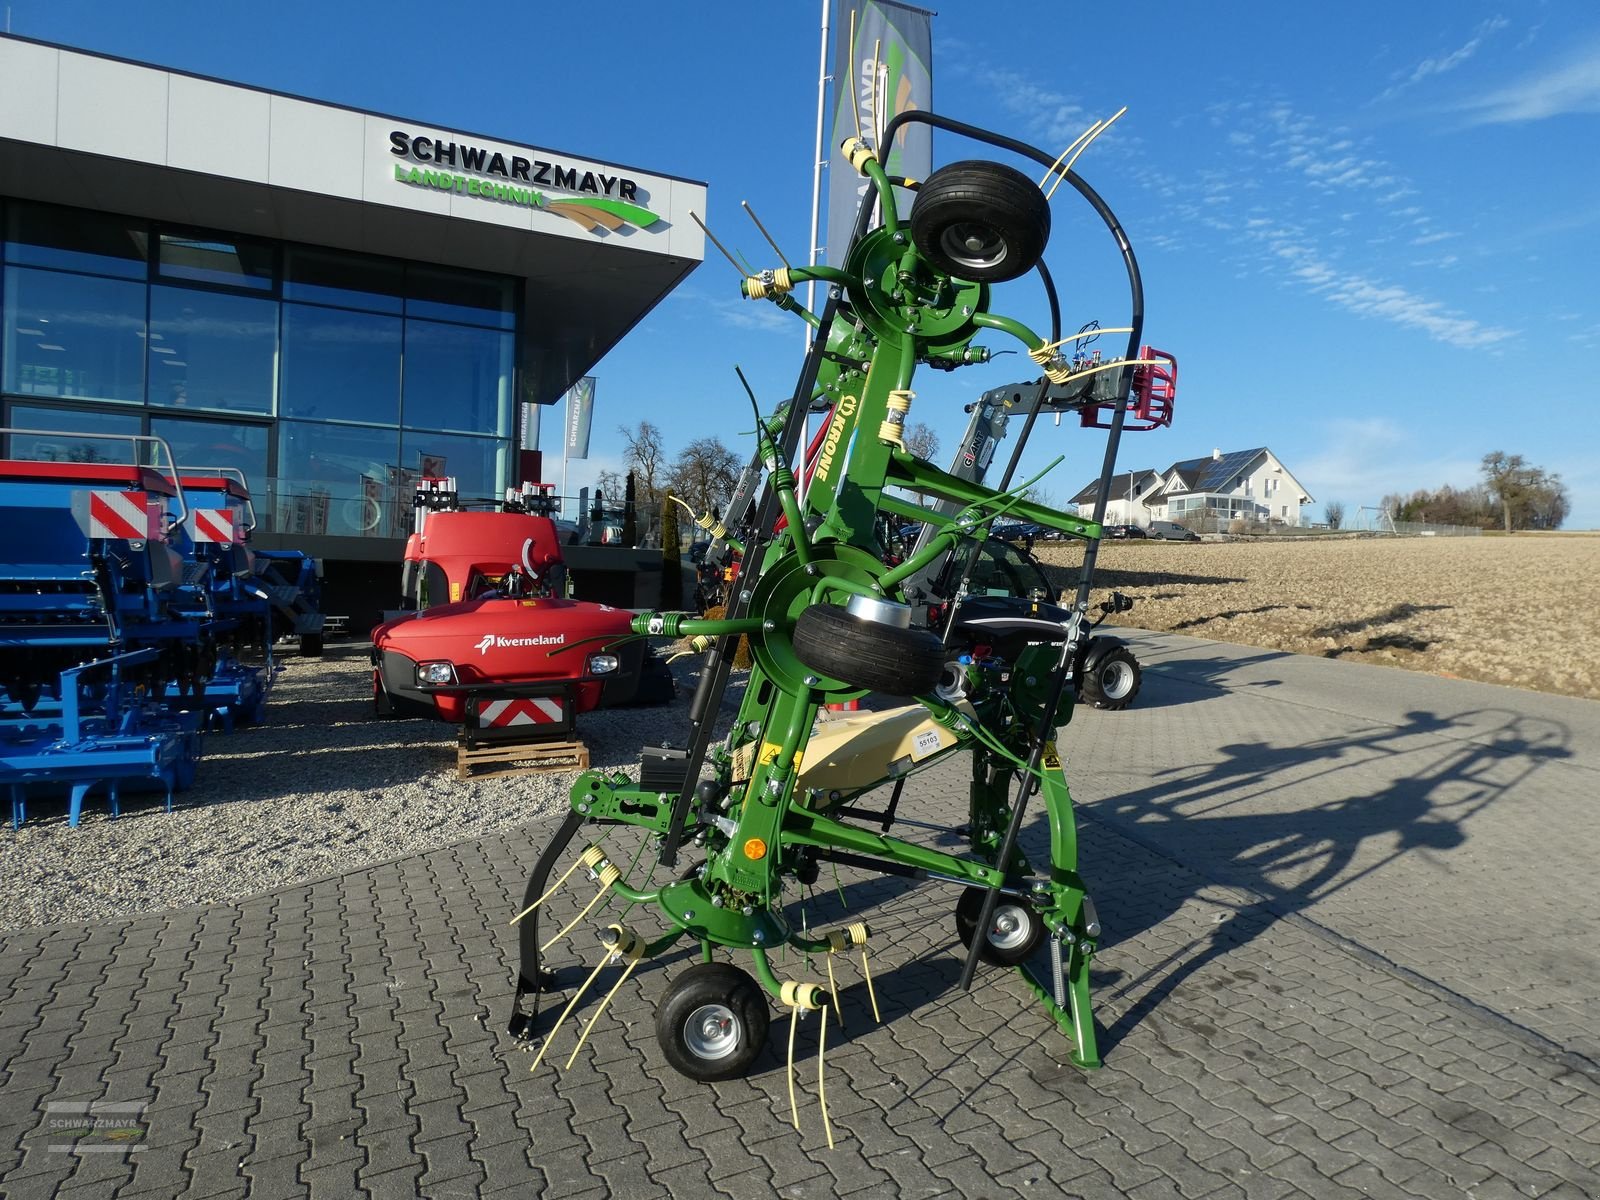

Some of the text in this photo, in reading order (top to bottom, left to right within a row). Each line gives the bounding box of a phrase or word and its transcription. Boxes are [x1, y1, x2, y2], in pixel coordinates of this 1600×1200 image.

[389, 131, 638, 200] SCHWARZMAYR
[394, 163, 544, 208] LANDTECHNIK
[815, 413, 846, 482] KRONE
[496, 633, 565, 648] Kverneland
[919, 735, 938, 748] 55103
